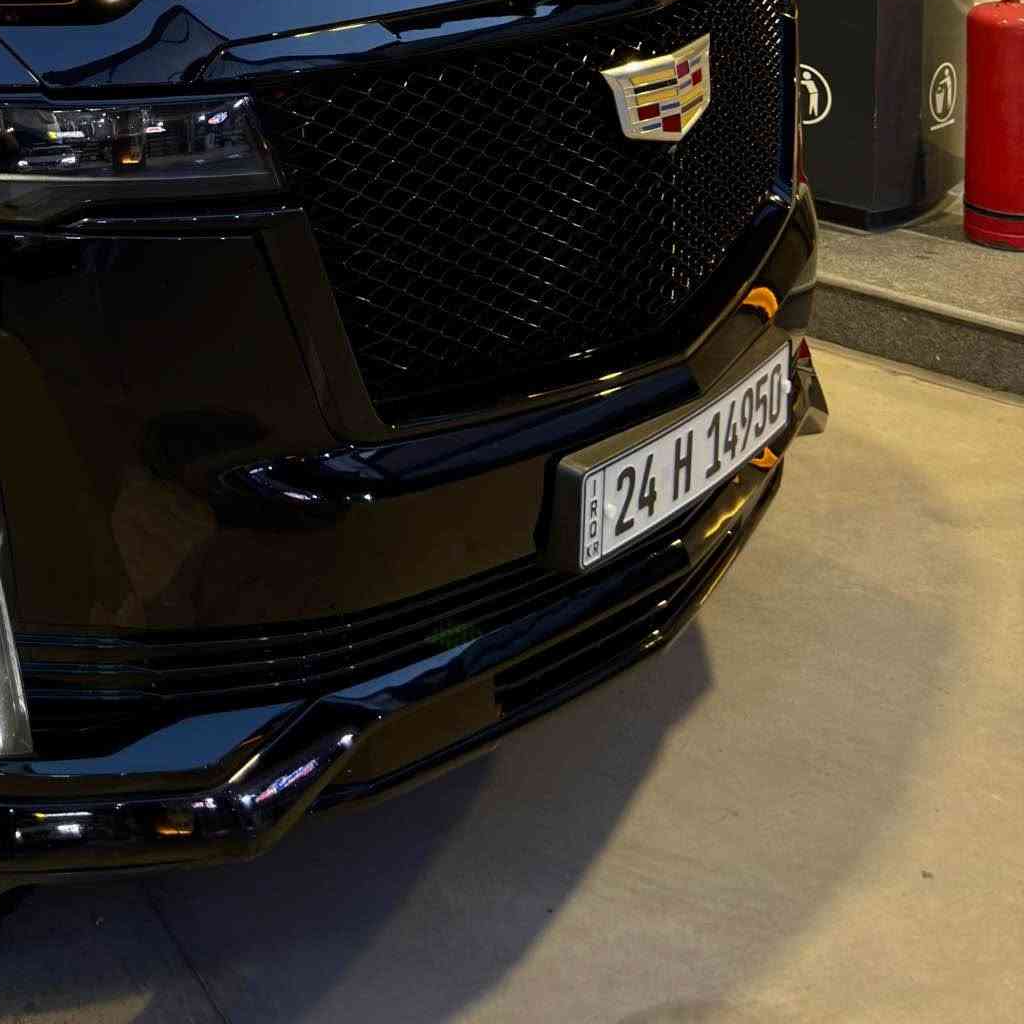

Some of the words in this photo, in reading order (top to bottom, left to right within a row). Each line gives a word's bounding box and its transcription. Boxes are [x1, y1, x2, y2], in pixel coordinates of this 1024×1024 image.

[614, 453, 657, 536] 24
[673, 429, 693, 501] H
[705, 363, 782, 478] 14950
